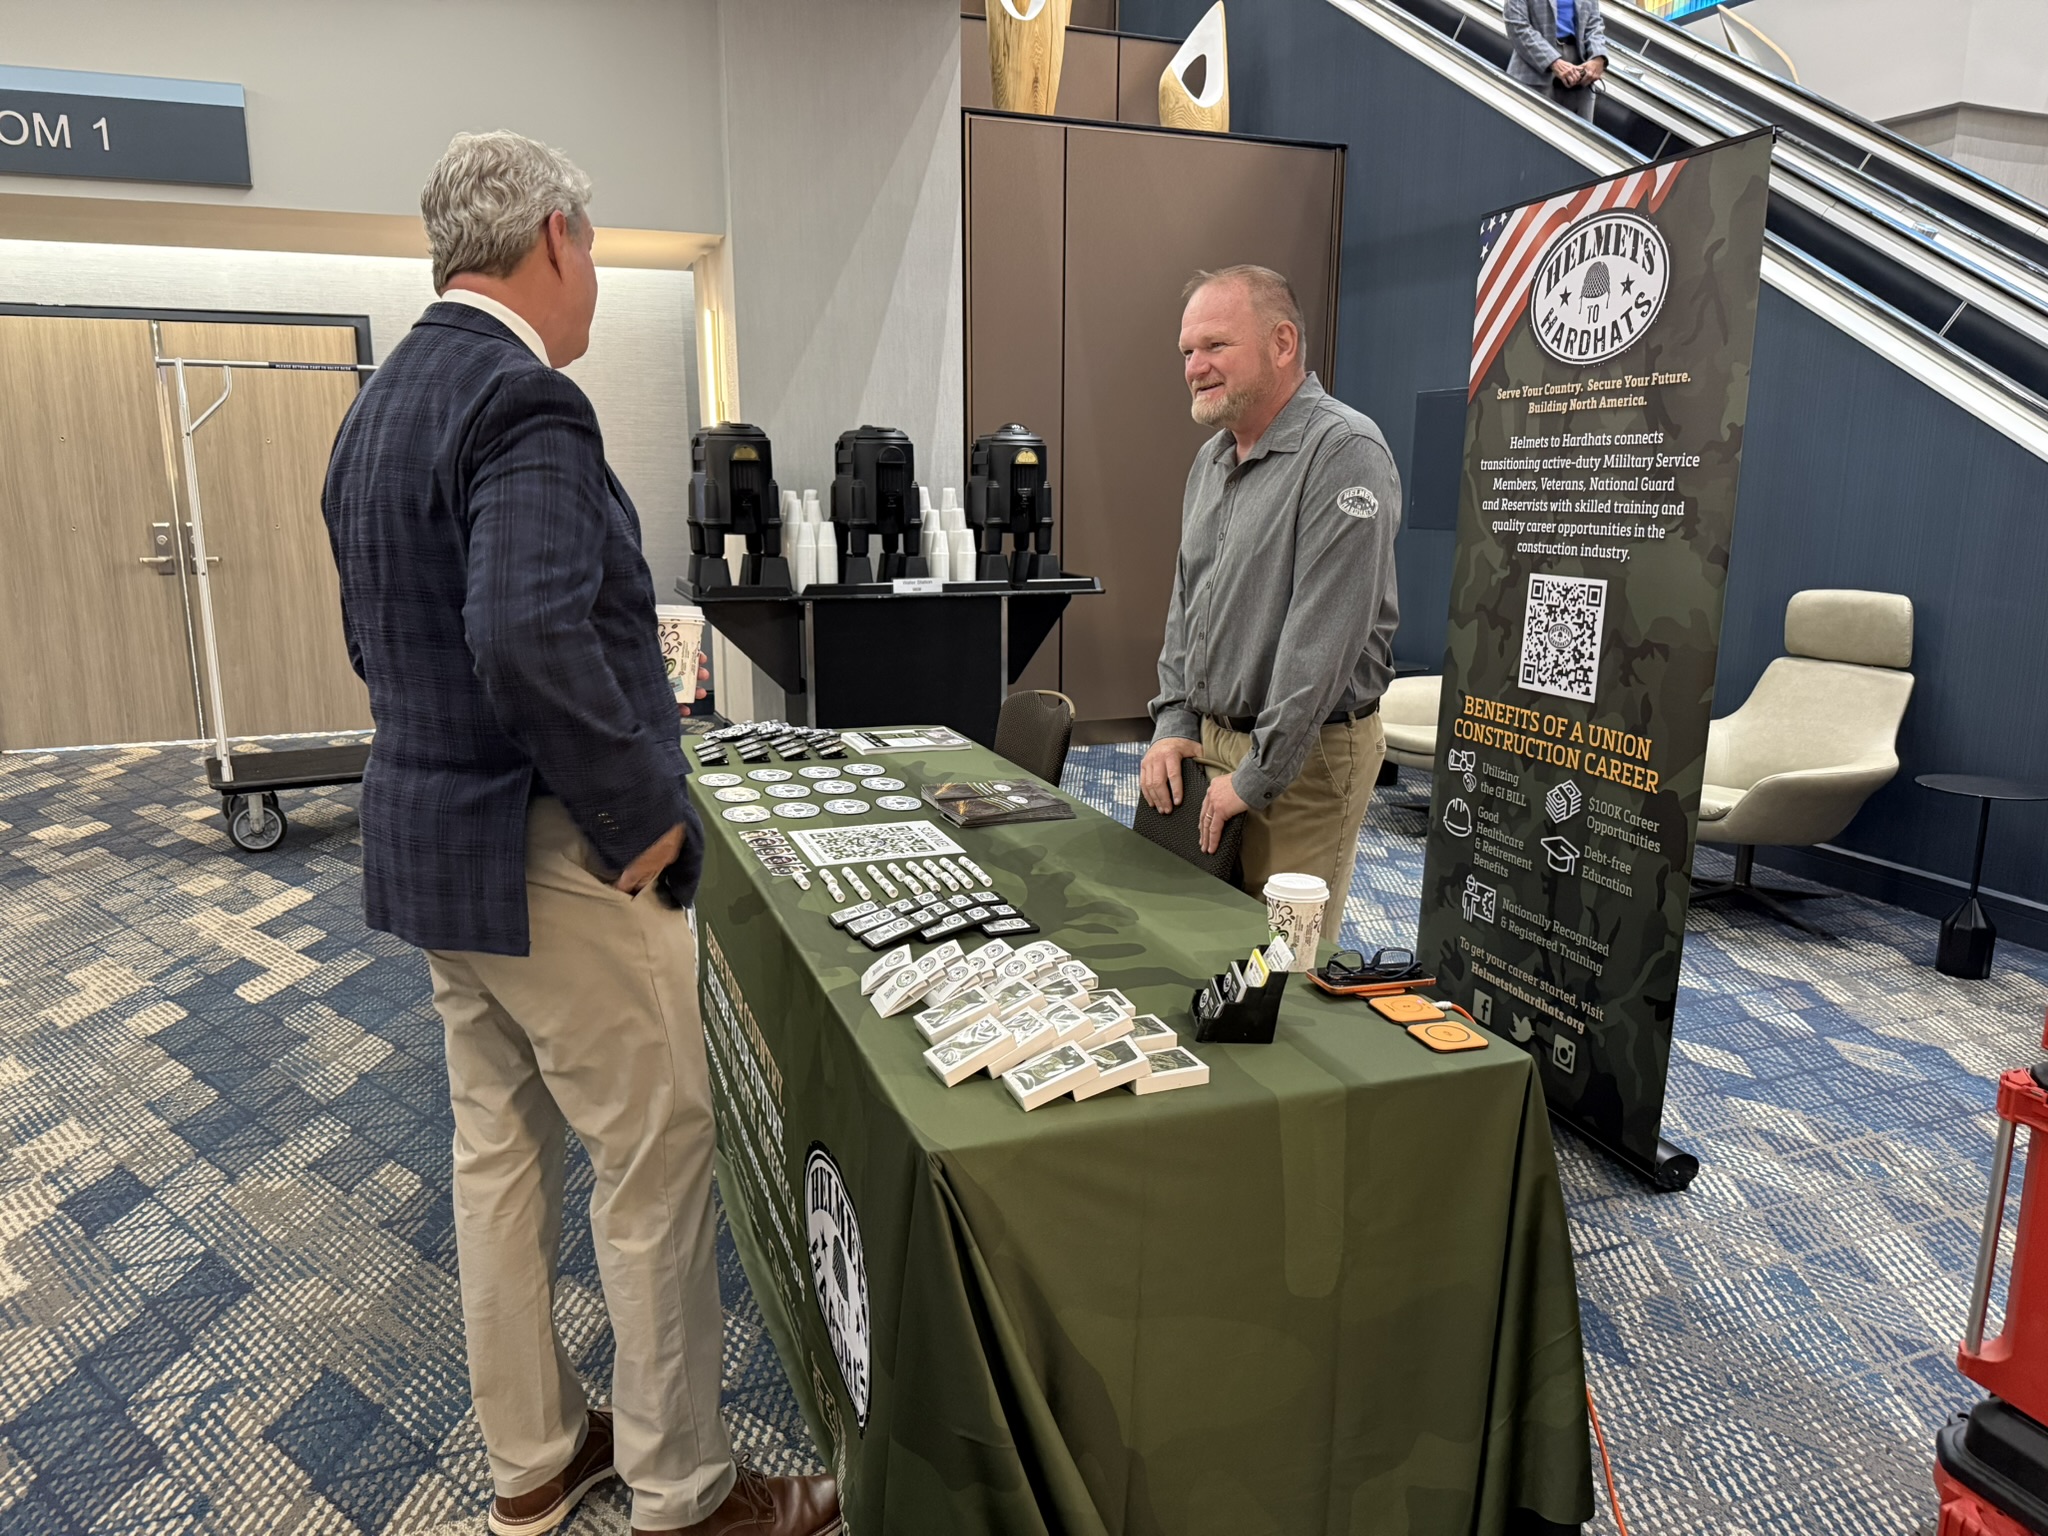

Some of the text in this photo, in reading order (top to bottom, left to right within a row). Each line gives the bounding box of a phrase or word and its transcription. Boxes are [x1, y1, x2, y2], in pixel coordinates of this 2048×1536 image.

[92, 116, 110, 151] 1
[1544, 223, 1656, 299] HELMETS
[1541, 291, 1652, 356] HARDHATS
[1587, 304, 1599, 325] TO
[1497, 372, 1691, 400] Serve Your Country. Secure Your Future.
[1528, 394, 1648, 414] Building North America.
[1510, 431, 1664, 450] Helmets to Hardhats connects
[1480, 457, 1541, 472] transitioning
[1542, 455, 1601, 471] active-duty
[1656, 452, 1700, 468] Service
[1493, 477, 1675, 492] Members, Veterans, National Guard
[1482, 498, 1684, 518] and Reservists with skilled training and
[1492, 518, 1665, 539] quality career opportunities in the
[1517, 541, 1630, 562] construction industry.
[1464, 695, 1652, 761] BENEFITS OF A UNION
[1454, 718, 1659, 794] CONSTRUCTION CAREER
[1482, 762, 1519, 787] Utilizing
[1481, 781, 1527, 807] the GI BILL
[1478, 806, 1499, 823] Good
[1588, 797, 1660, 833] $100K Career
[1476, 822, 1524, 850] Healthcare
[1587, 816, 1661, 853] Opportunities
[1473, 853, 1509, 877] Benefits
[1474, 837, 1533, 871] & Retirement
[1584, 845, 1632, 875] Debt-free
[1582, 865, 1633, 897] Education
[1502, 897, 1609, 957] Nationally Recognized
[1501, 917, 1603, 977] & Registered Training
[1460, 936, 1604, 1022] To get your career started, visit
[1471, 962, 1585, 1035] Helmetstohardhats.org
